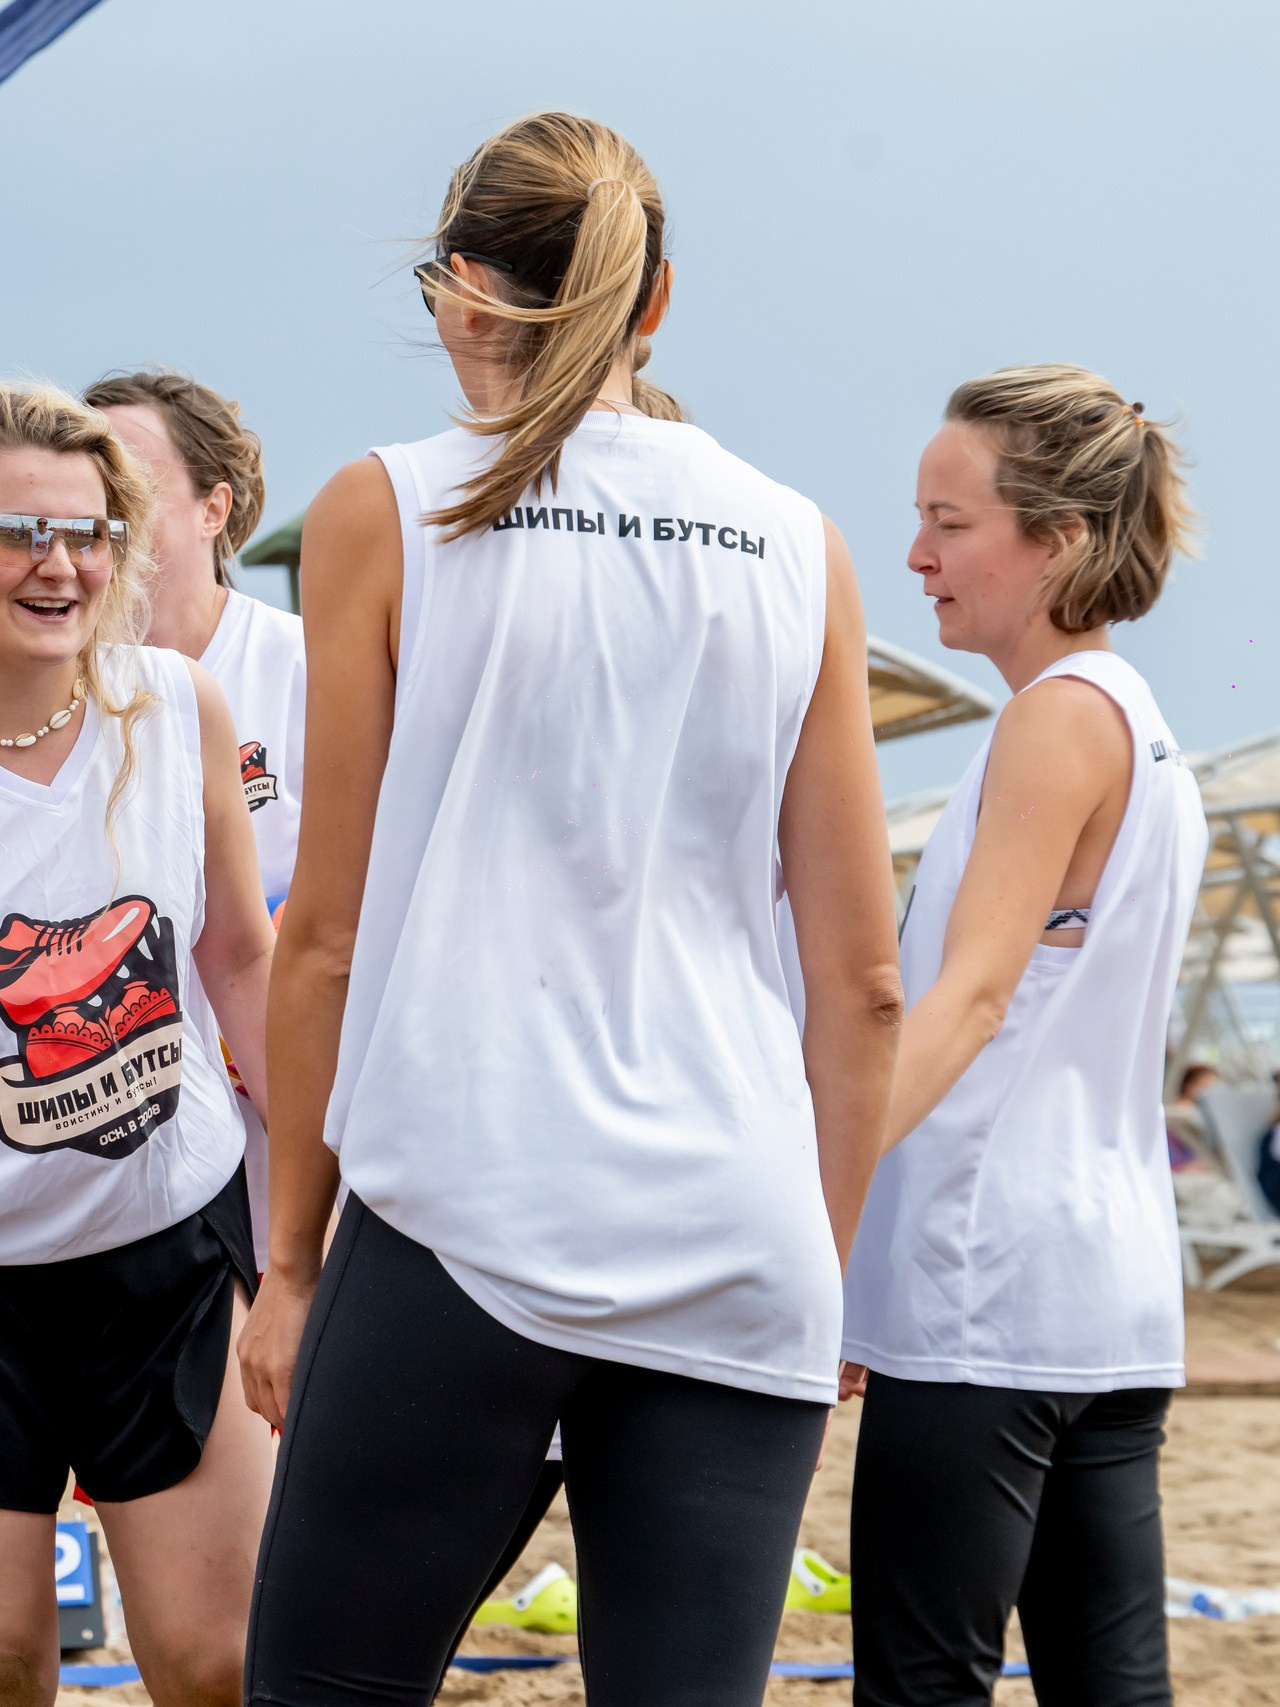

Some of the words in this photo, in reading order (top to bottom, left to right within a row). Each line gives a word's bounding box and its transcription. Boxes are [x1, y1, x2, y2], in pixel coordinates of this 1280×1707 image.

[493, 506, 605, 535] ШИПЫ
[619, 513, 642, 538] И
[653, 518, 765, 559] БУТСЫ
[17, 1083, 97, 1125] ШИПЫ
[100, 1072, 119, 1098] И
[121, 1039, 181, 1087] БУТСЫ
[99, 1126, 128, 1146] ОСН.
